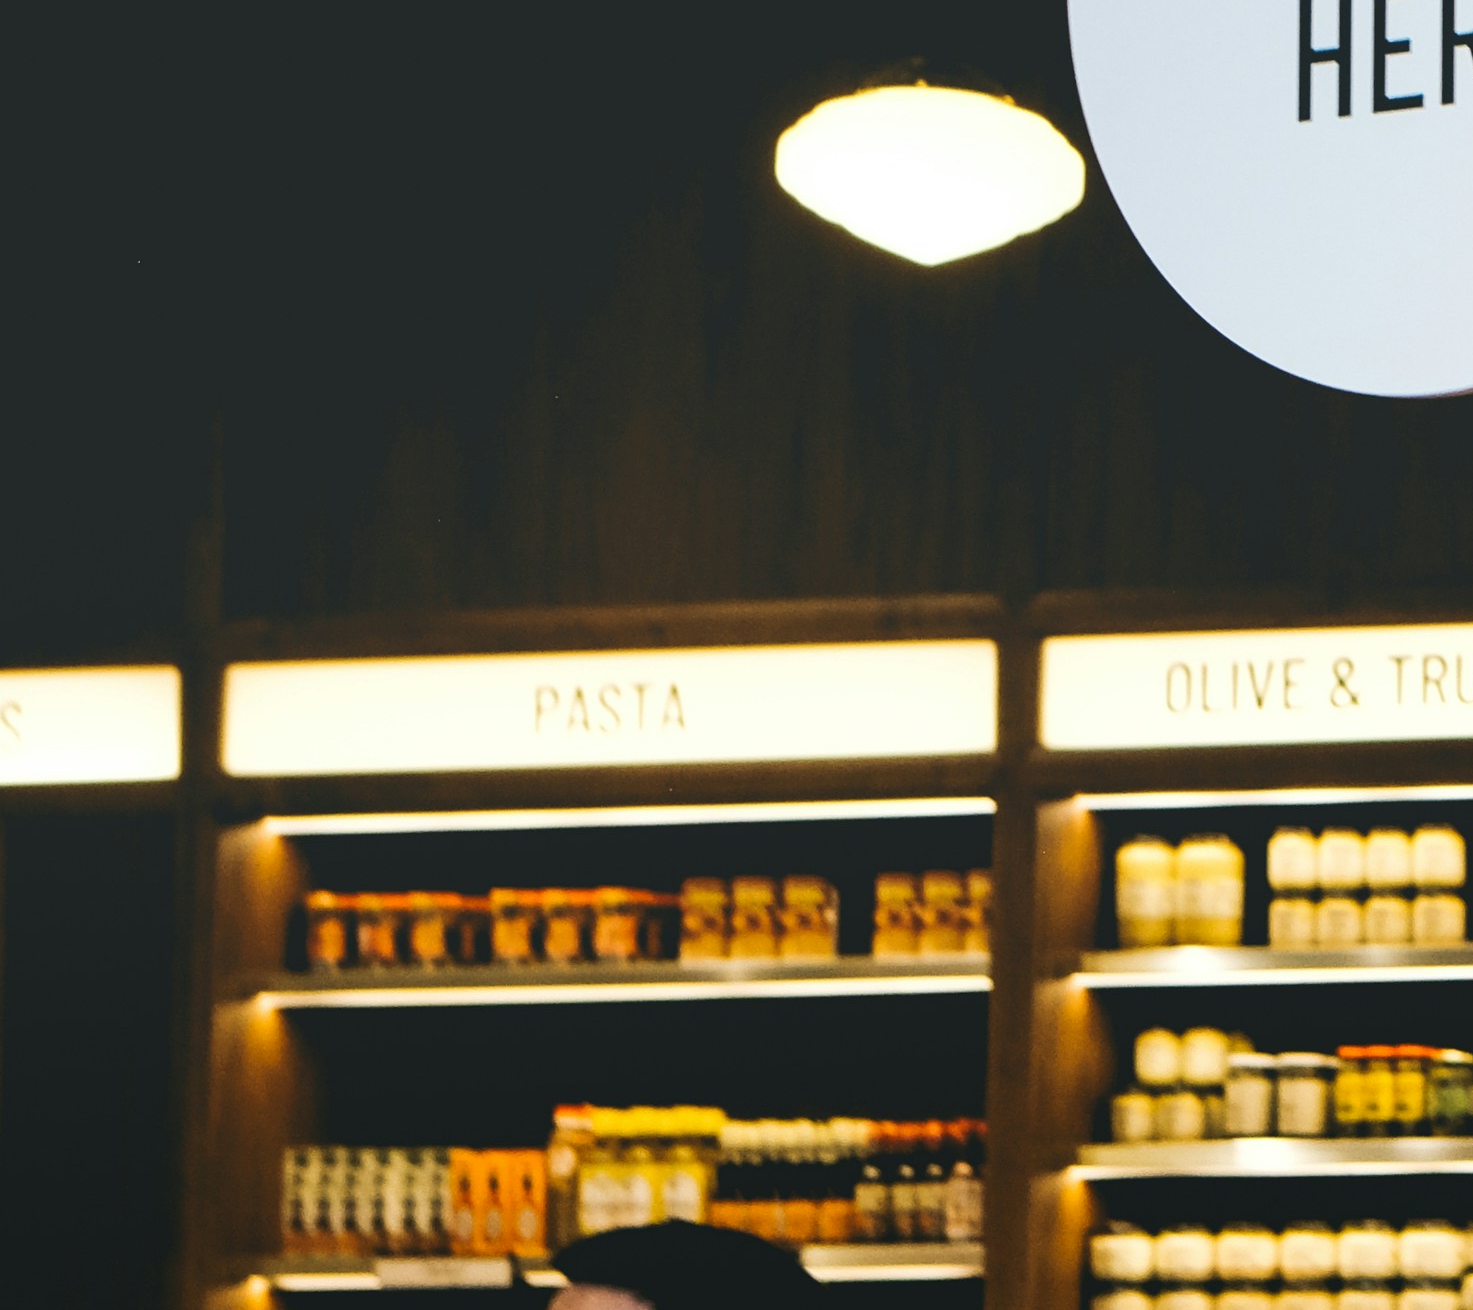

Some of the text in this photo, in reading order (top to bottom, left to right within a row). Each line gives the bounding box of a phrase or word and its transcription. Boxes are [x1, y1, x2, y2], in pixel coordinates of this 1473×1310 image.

[533, 682, 687, 734] PASTA
[1164, 657, 1306, 715] OLIVE
[1328, 655, 1362, 710] &
